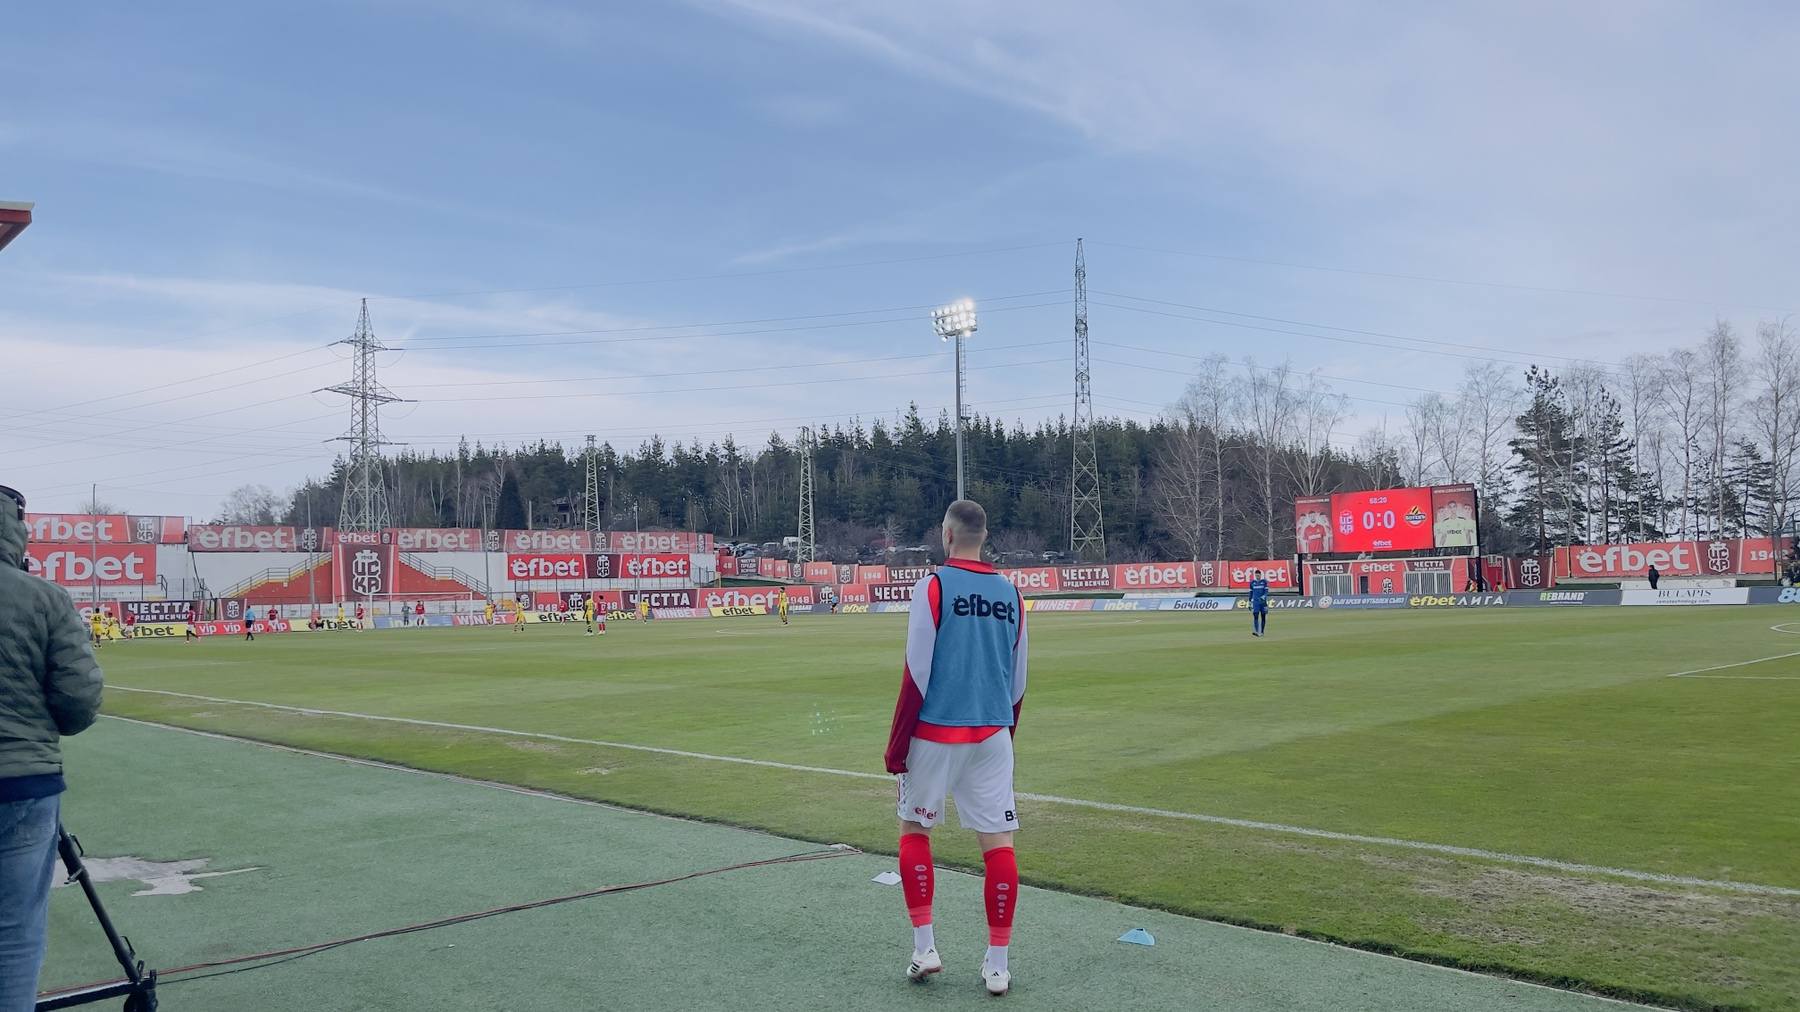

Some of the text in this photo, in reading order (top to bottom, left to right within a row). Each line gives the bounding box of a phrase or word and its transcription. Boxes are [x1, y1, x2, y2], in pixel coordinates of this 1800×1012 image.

[1362, 511, 1396, 529] 0:0
[199, 527, 289, 549] efbet
[339, 532, 377, 543] efbet
[397, 530, 470, 549] efbet
[515, 532, 581, 549] efbet
[622, 533, 680, 549] efbet
[1580, 546, 1689, 573] efbet
[511, 558, 580, 577] efbet
[627, 558, 688, 575] efbet
[1361, 562, 1396, 572] efbet
[1009, 570, 1049, 589] fbet
[1062, 567, 1109, 580] ЧЕСТТА
[1124, 565, 1188, 585] efbet
[706, 590, 779, 609] efbet
[843, 594, 865, 602] 1948
[1410, 595, 1504, 606] efbet ЛИГА
[1540, 592, 1584, 600] REBRAND
[128, 602, 190, 614] ЧЕСТТА
[842, 603, 869, 613] efbet
[952, 594, 1015, 624] efbet
[1036, 600, 1079, 610] WINBET
[1104, 600, 1138, 610] inbet
[1173, 599, 1219, 610] Бачково
[1275, 600, 1313, 608] ЛИГА
[722, 607, 755, 617] efbet
[457, 615, 508, 625] WINET
[199, 623, 217, 637] vip
[222, 622, 241, 636] vip
